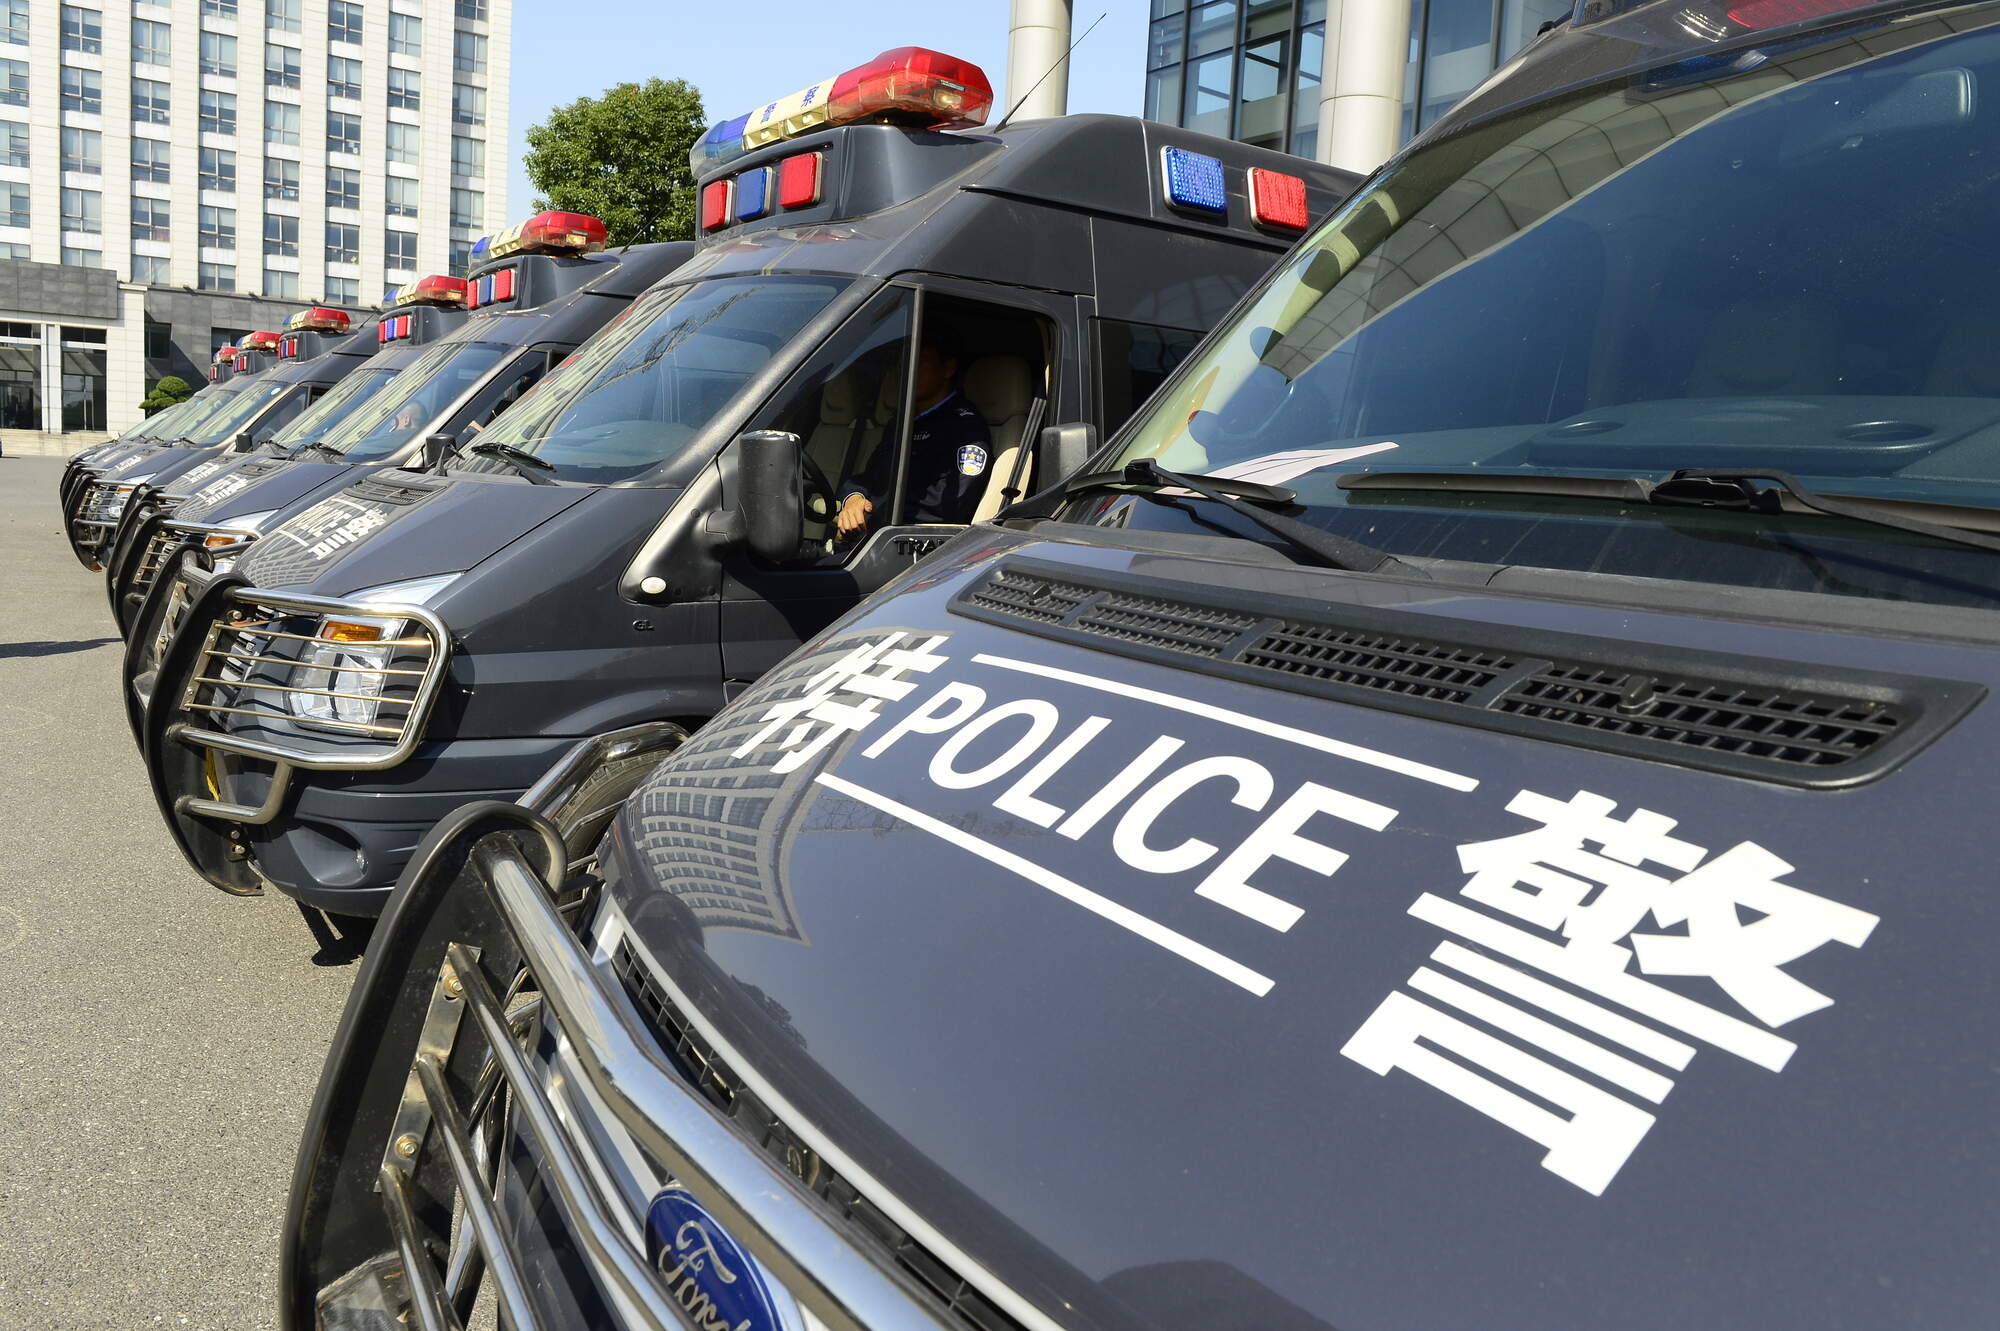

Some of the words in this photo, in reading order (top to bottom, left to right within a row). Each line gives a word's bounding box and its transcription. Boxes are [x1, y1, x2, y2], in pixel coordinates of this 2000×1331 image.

[731, 631, 950, 774] 特
[861, 681, 1400, 933] POLICE
[1340, 789, 1880, 1198] 警
